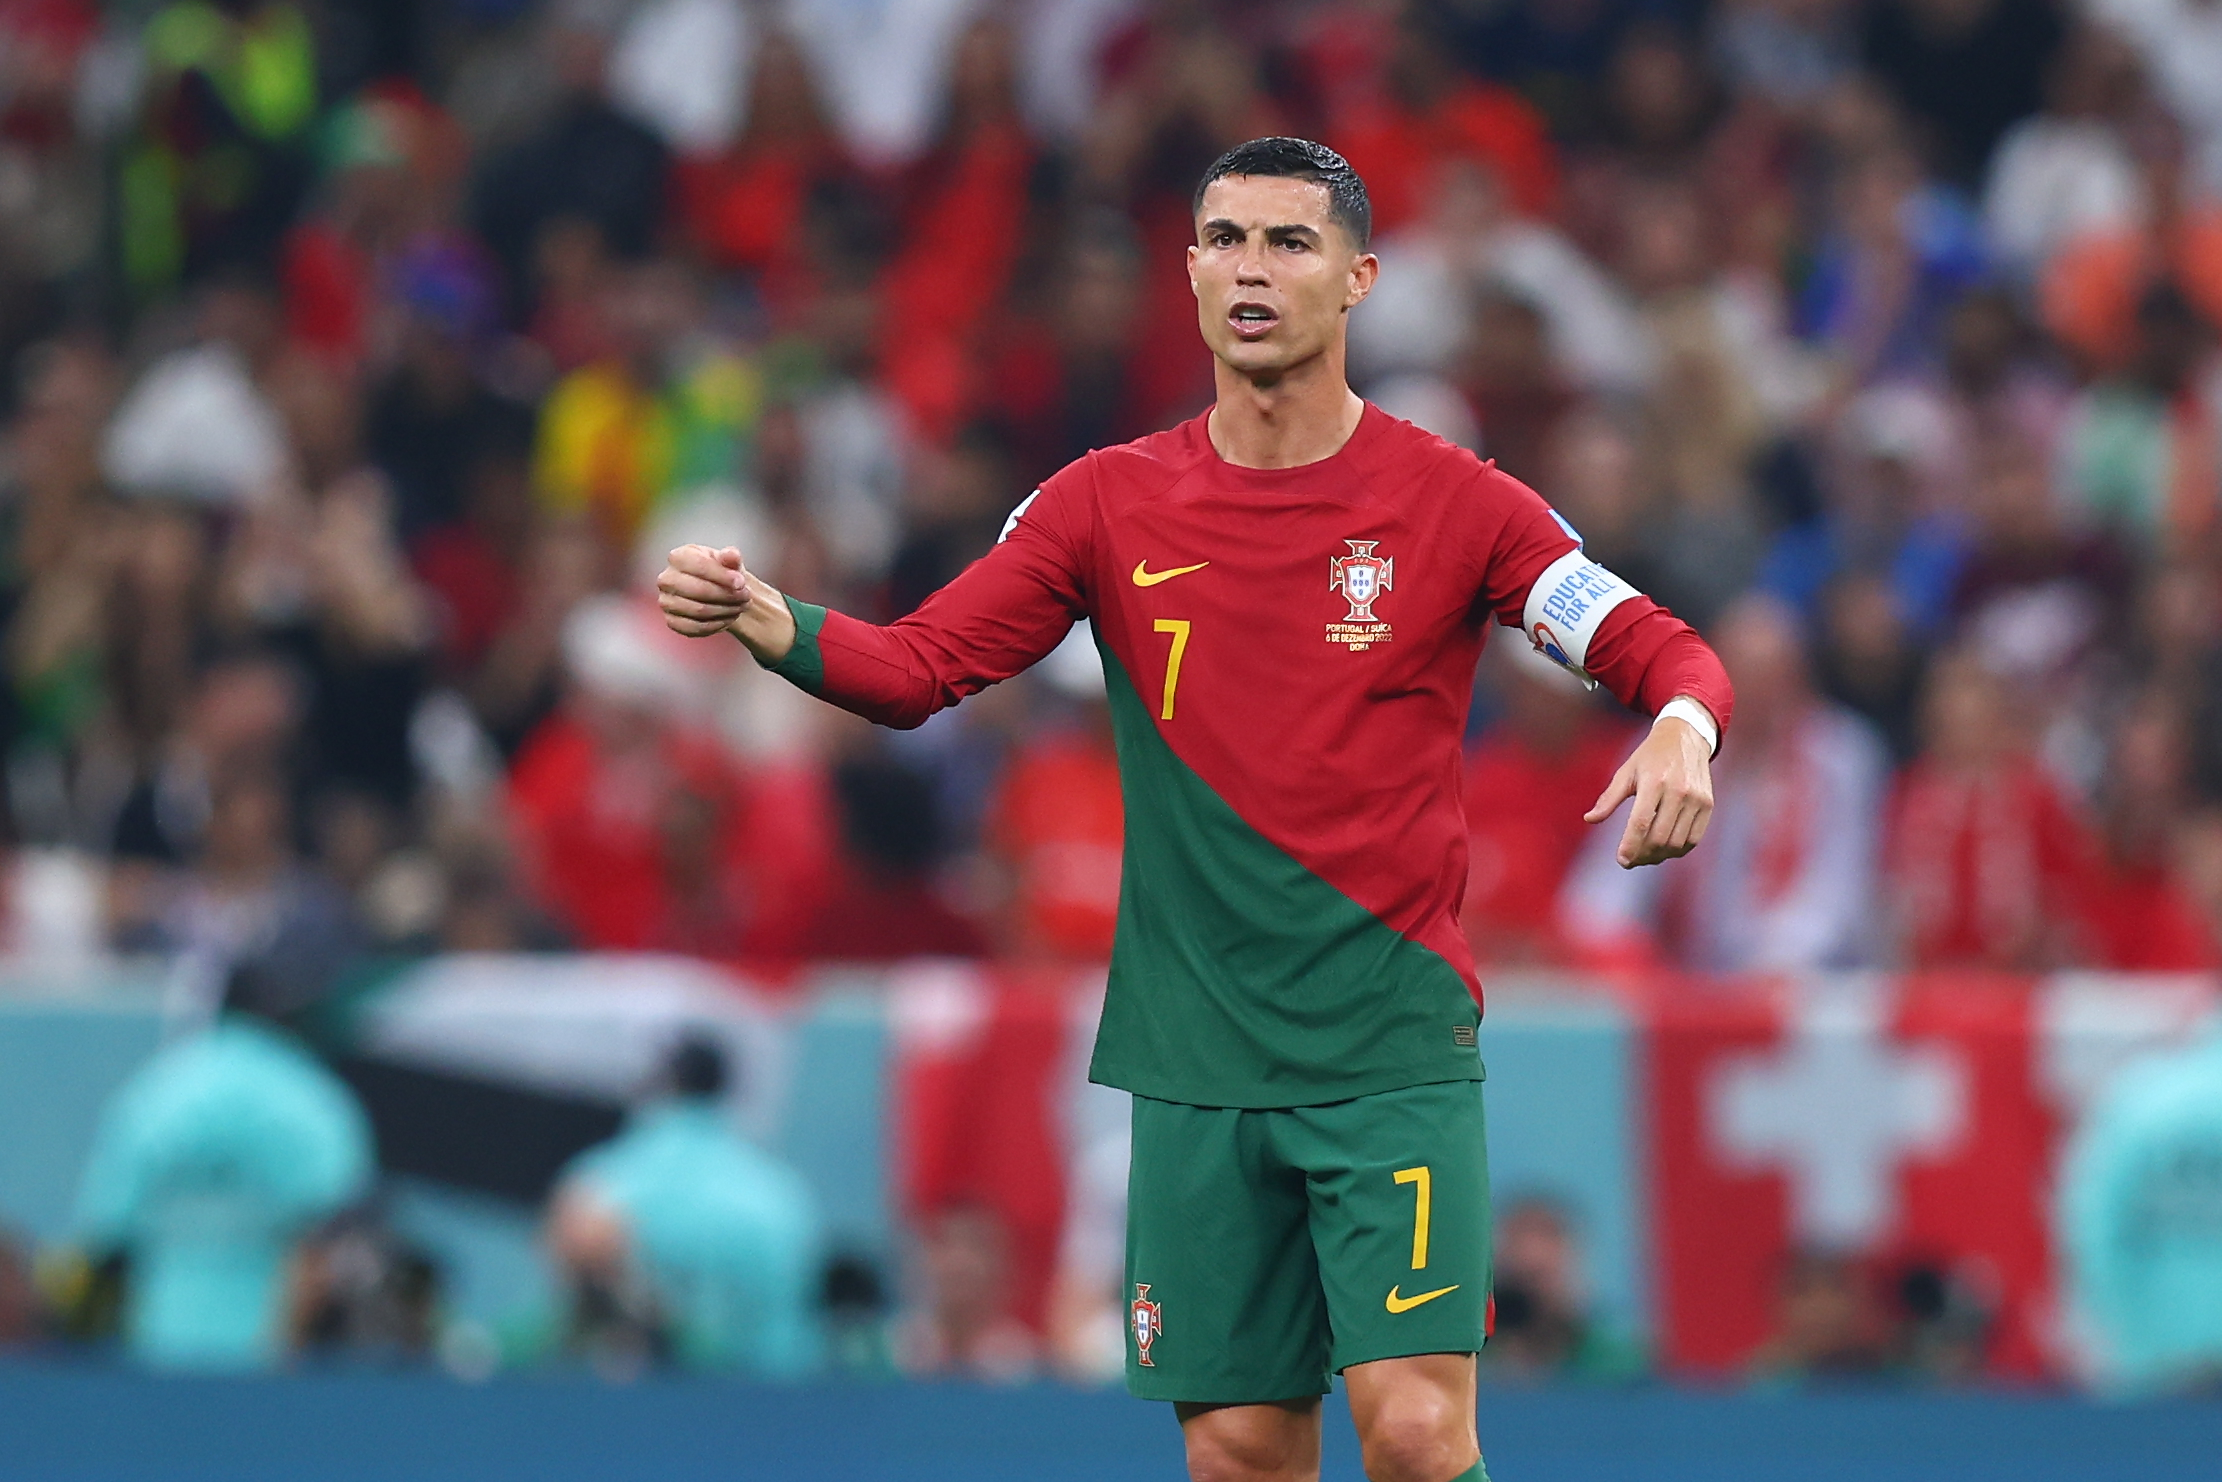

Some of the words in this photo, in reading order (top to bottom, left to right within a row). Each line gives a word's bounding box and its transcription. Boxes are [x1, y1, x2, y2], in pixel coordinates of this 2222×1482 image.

[1560, 596, 1590, 632] FOR
[1585, 578, 1617, 601] ALL
[1325, 624, 1364, 633] PORTUGAL
[1325, 634, 1331, 642] 6
[1331, 633, 1340, 642] DE
[1374, 633, 1392, 642] 2022
[1349, 643, 1369, 651] DOHA
[1153, 619, 1191, 720] 7
[1393, 1166, 1430, 1269] 7
